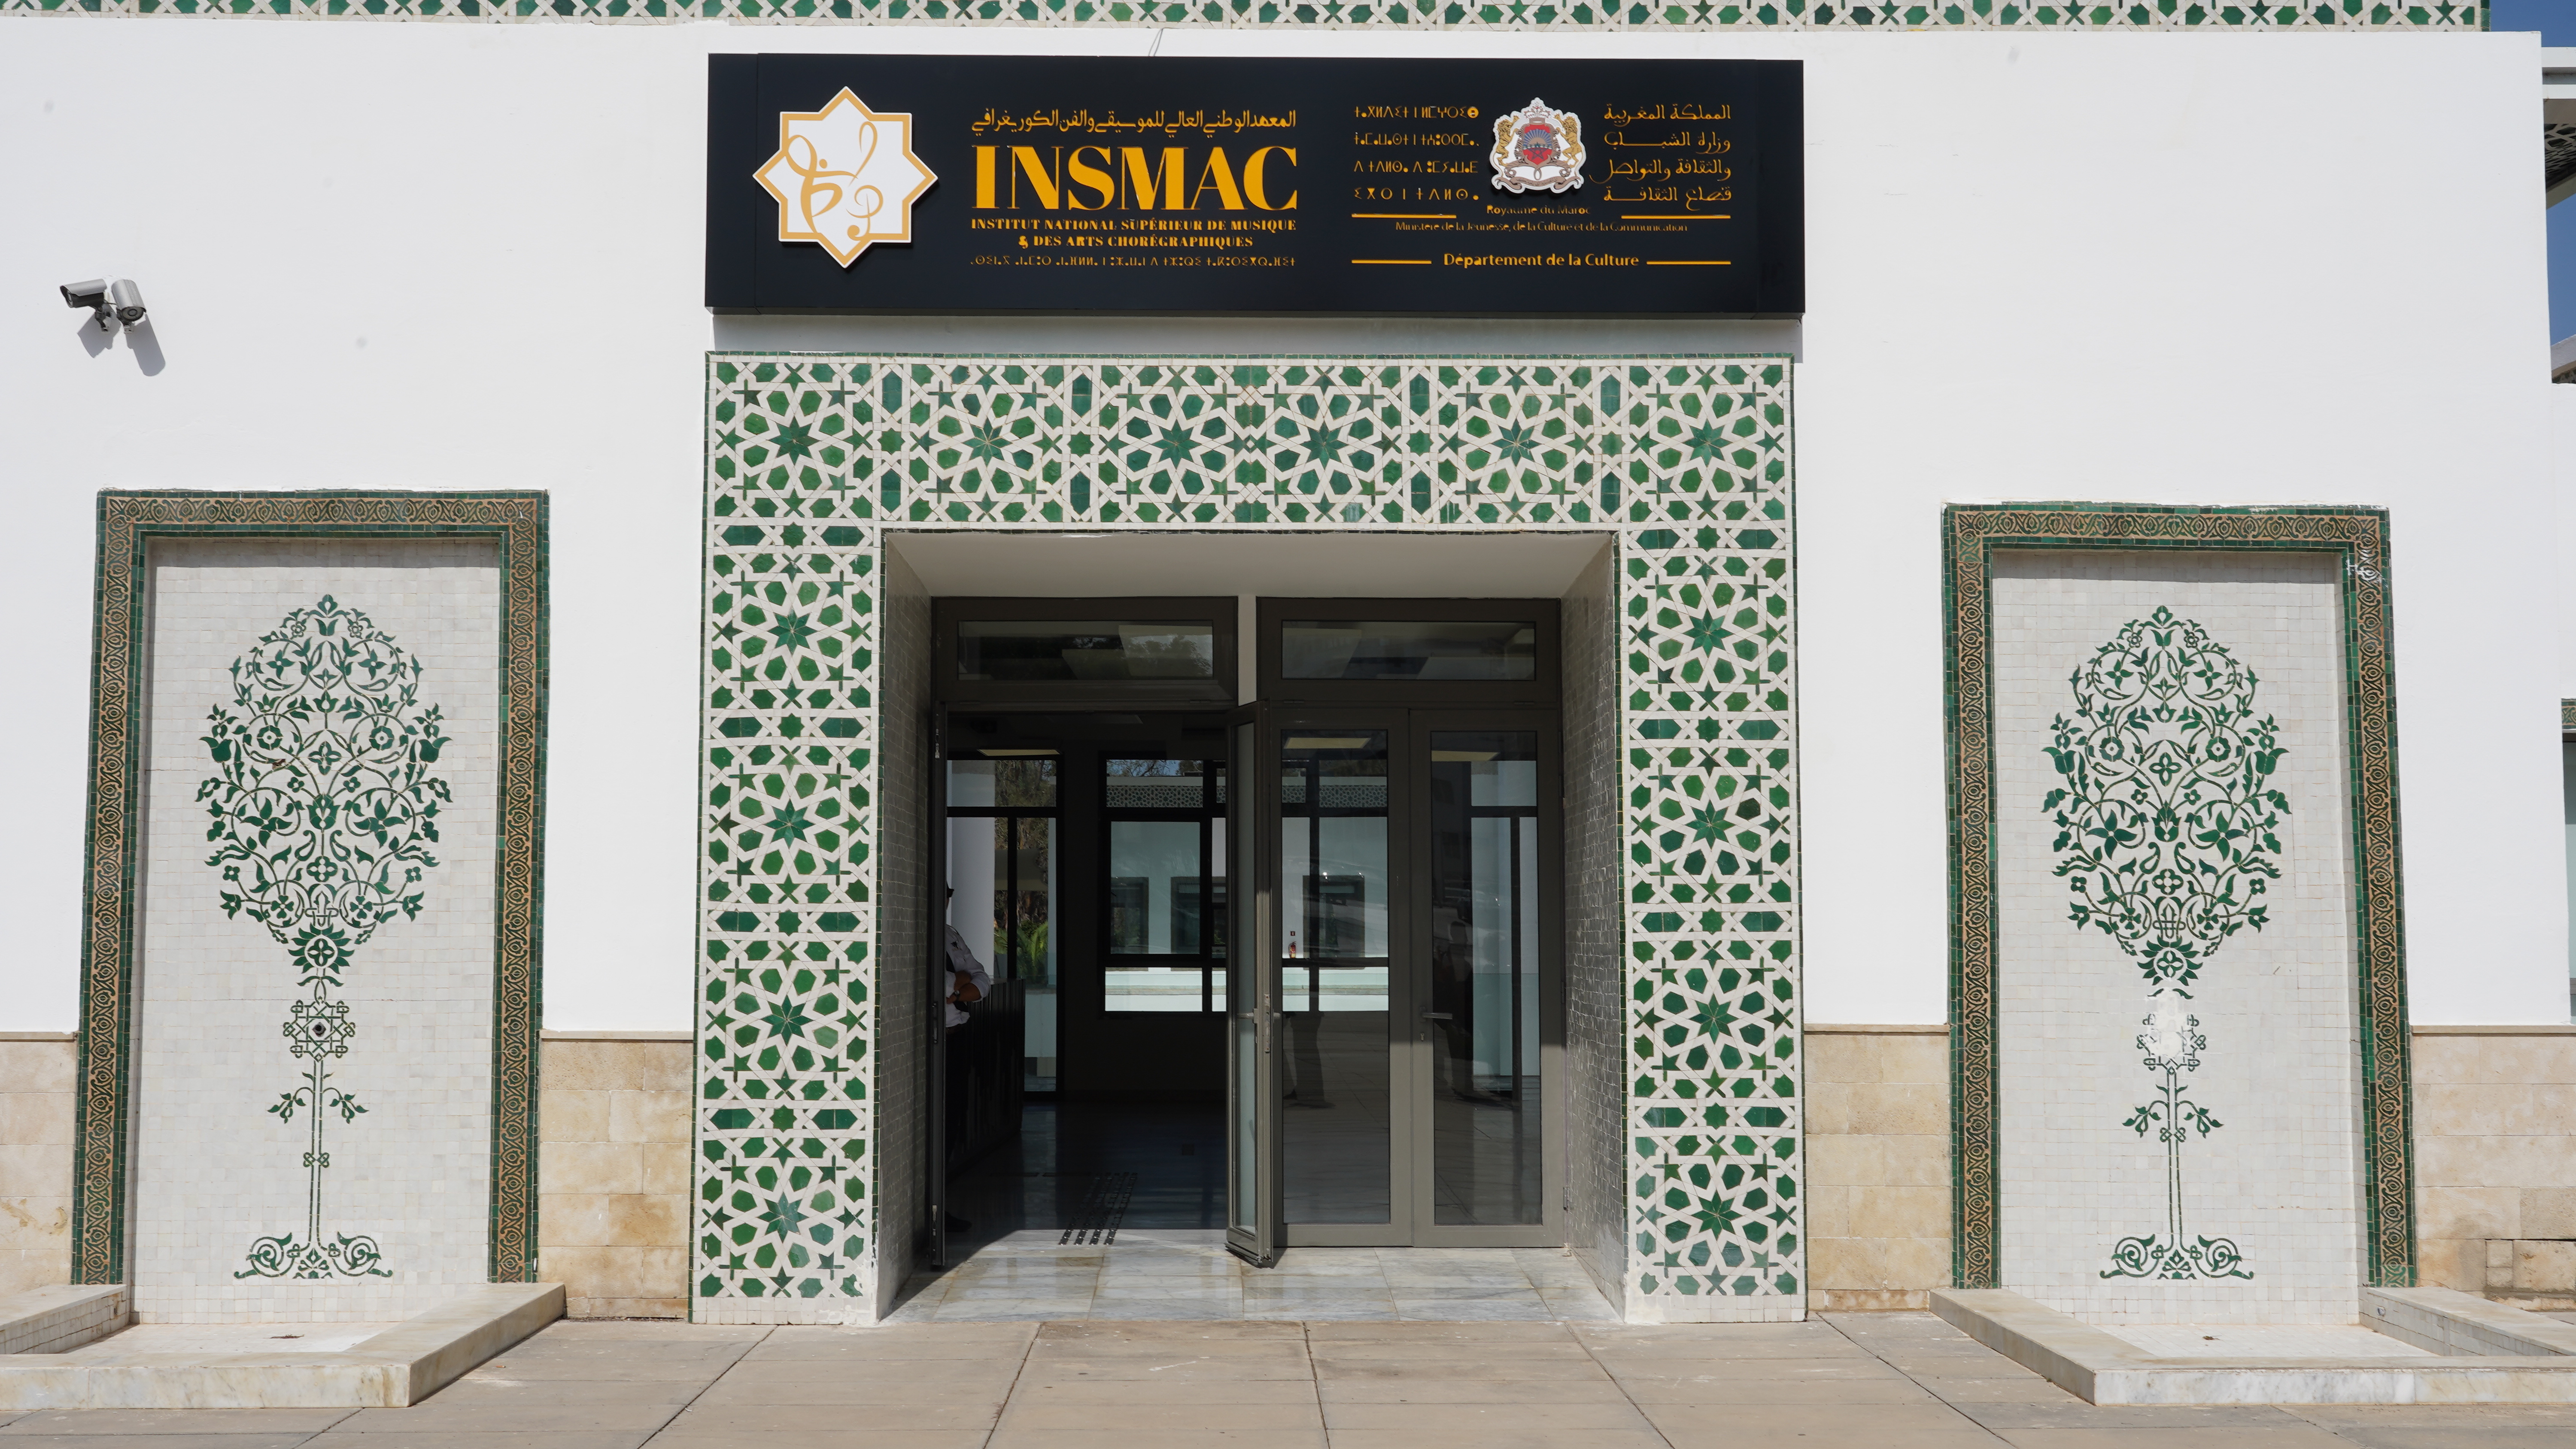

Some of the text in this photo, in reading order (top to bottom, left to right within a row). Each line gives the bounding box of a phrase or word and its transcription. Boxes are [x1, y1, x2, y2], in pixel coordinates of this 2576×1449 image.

[1604, 103, 1731, 127] المملكة المغربية
[1604, 132, 1730, 154] وزارة الشباب
[972, 145, 1297, 211] INSMAC
[1589, 158, 1731, 183] والثقافة والتواصل
[1604, 186, 1677, 201] الثقافة
[1487, 205, 1589, 216] Royaume du Maroc
[972, 217, 1296, 233] INSTITUT NATIONAL SUPÉRIEUR DE MUSIQUE
[1441, 222, 1454, 230] de
[1456, 222, 1464, 230] la
[1513, 221, 1525, 230] de
[1528, 222, 1535, 230] la
[1537, 221, 1572, 230] Culture
[1586, 222, 1598, 230] de
[1600, 222, 1608, 231] la
[1018, 234, 1253, 250] & DES ARTS CHORÉGRAPHIQUES
[1444, 253, 1639, 269] Département de la Culture
